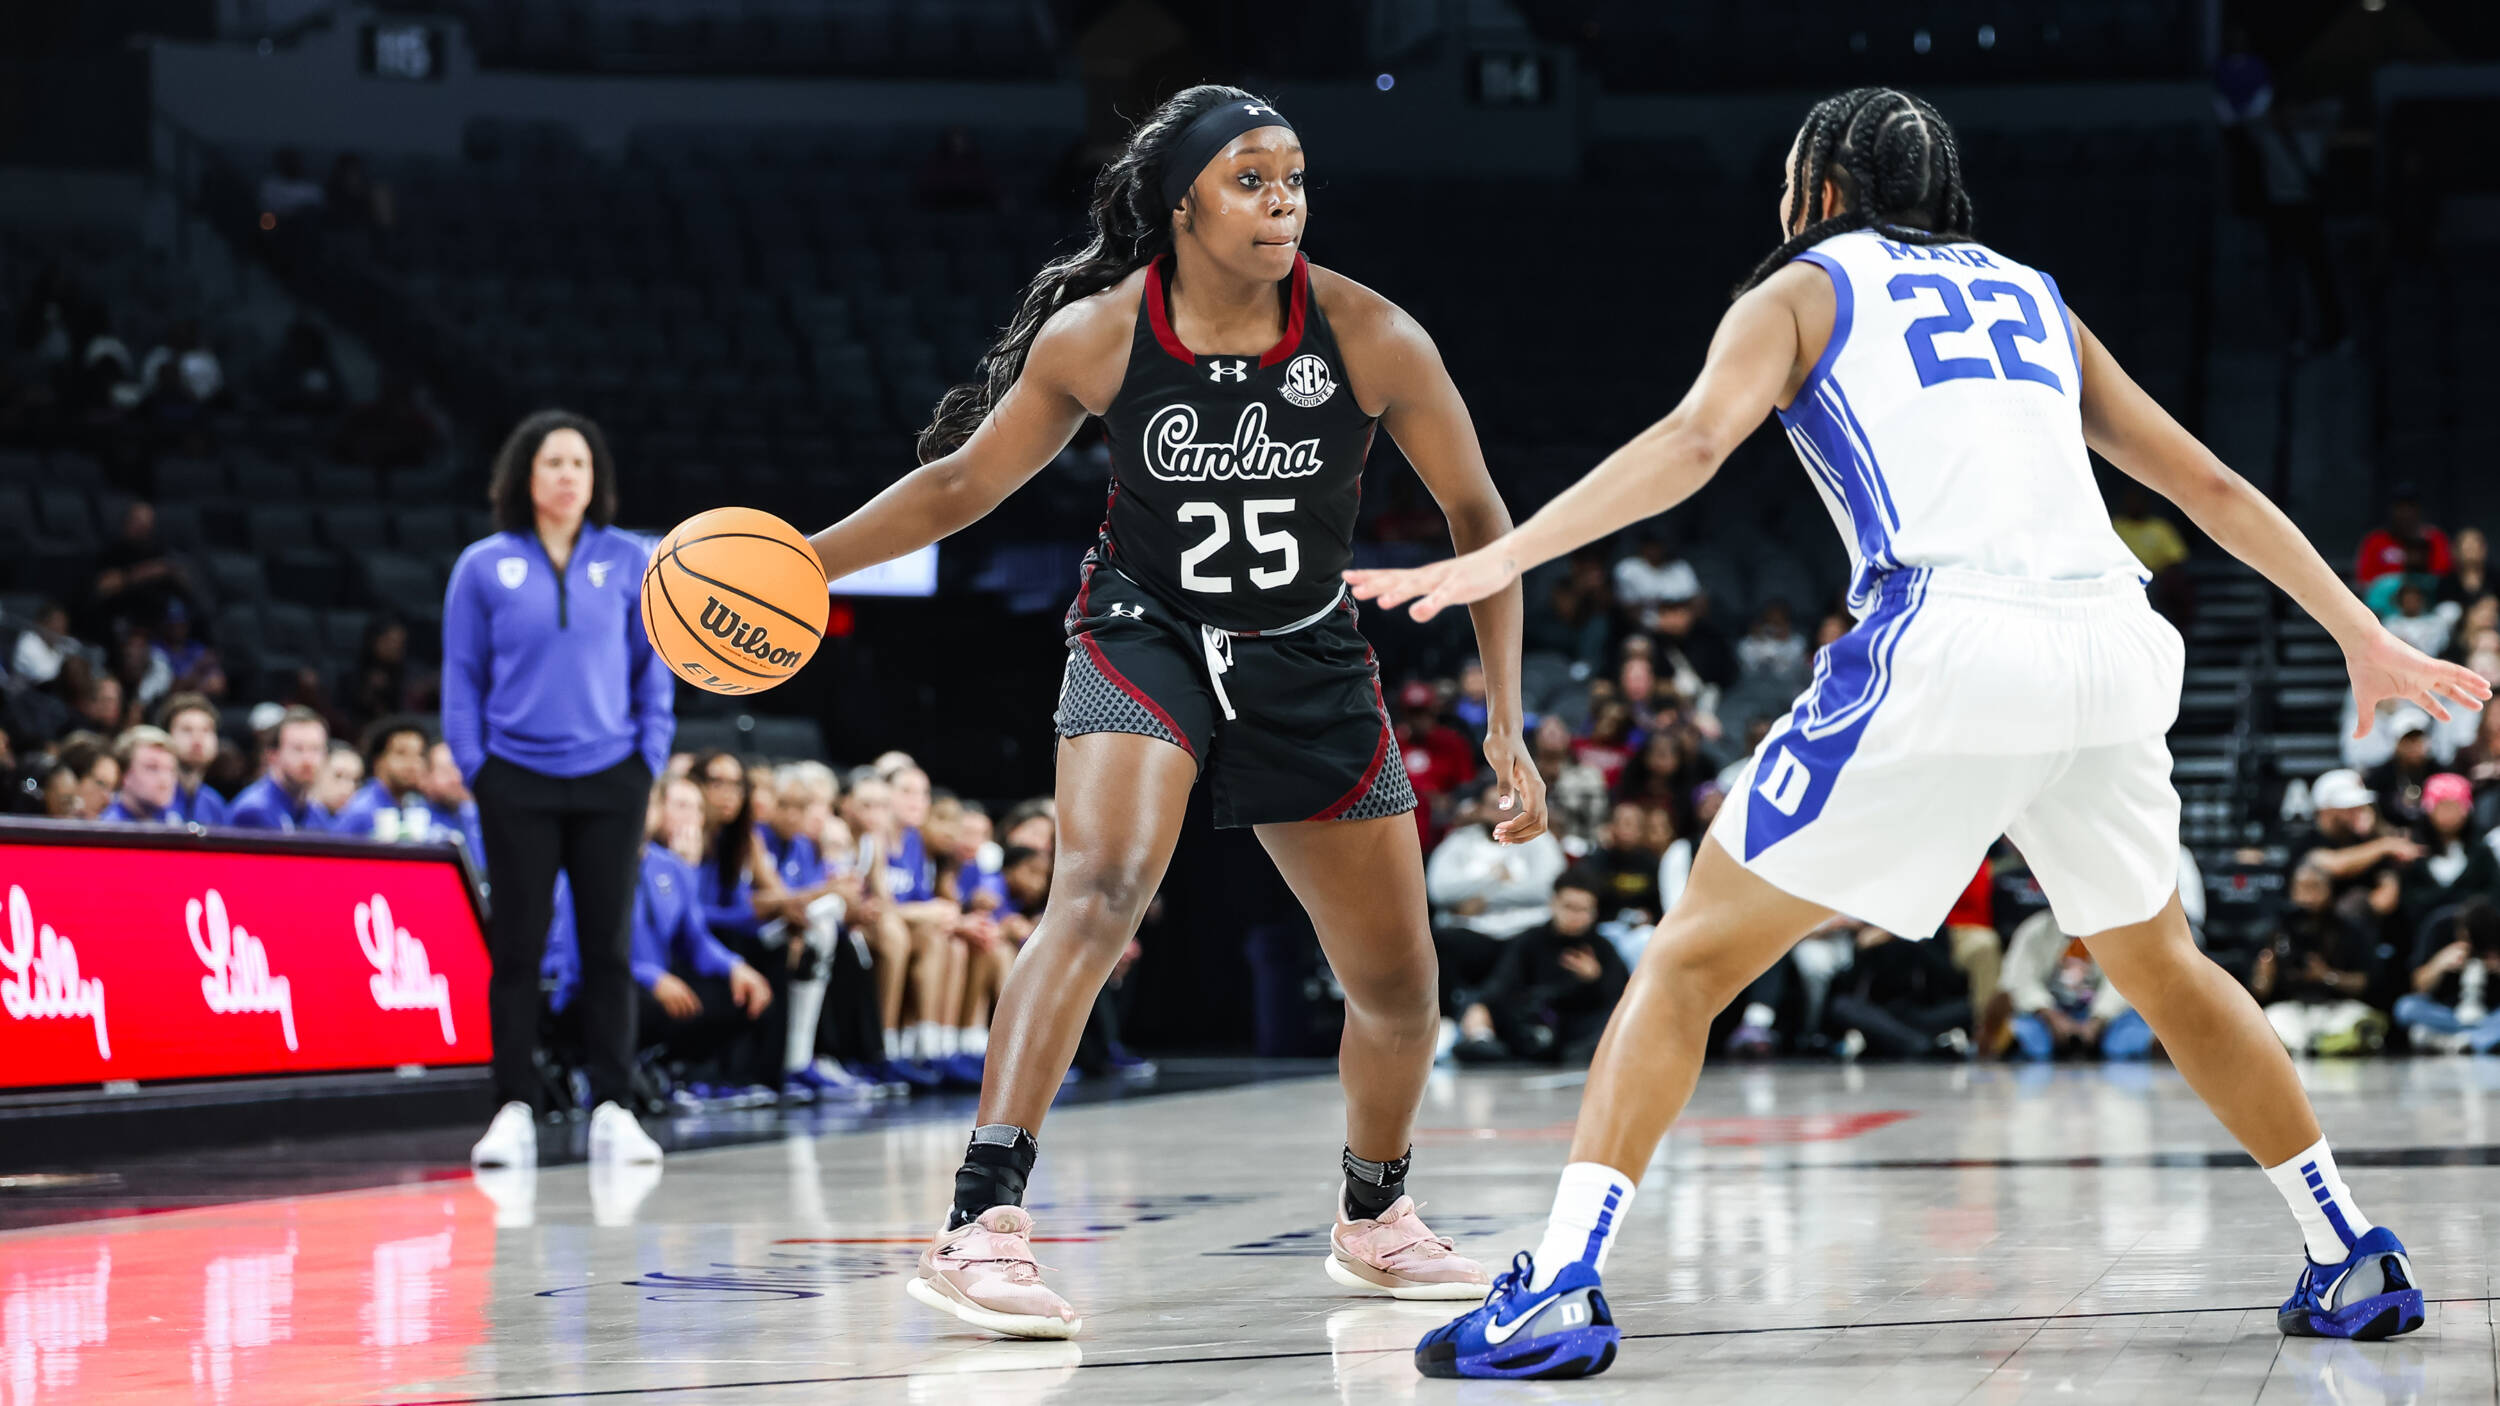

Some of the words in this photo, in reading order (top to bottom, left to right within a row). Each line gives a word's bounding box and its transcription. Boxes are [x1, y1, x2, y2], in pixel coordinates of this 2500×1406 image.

[1877, 240, 2000, 269] MAIR
[1886, 273, 2065, 396] 22
[1286, 390, 1331, 407] GRADUATE
[1290, 358, 1325, 394] SEC
[1143, 402, 1324, 481] Carolina
[1177, 498, 1300, 593] 25
[699, 595, 803, 668] Wilson
[1757, 744, 1811, 816] D
[0, 884, 111, 1060] Lilly
[186, 888, 299, 1052] Lilly
[354, 893, 456, 1045] Lilly
